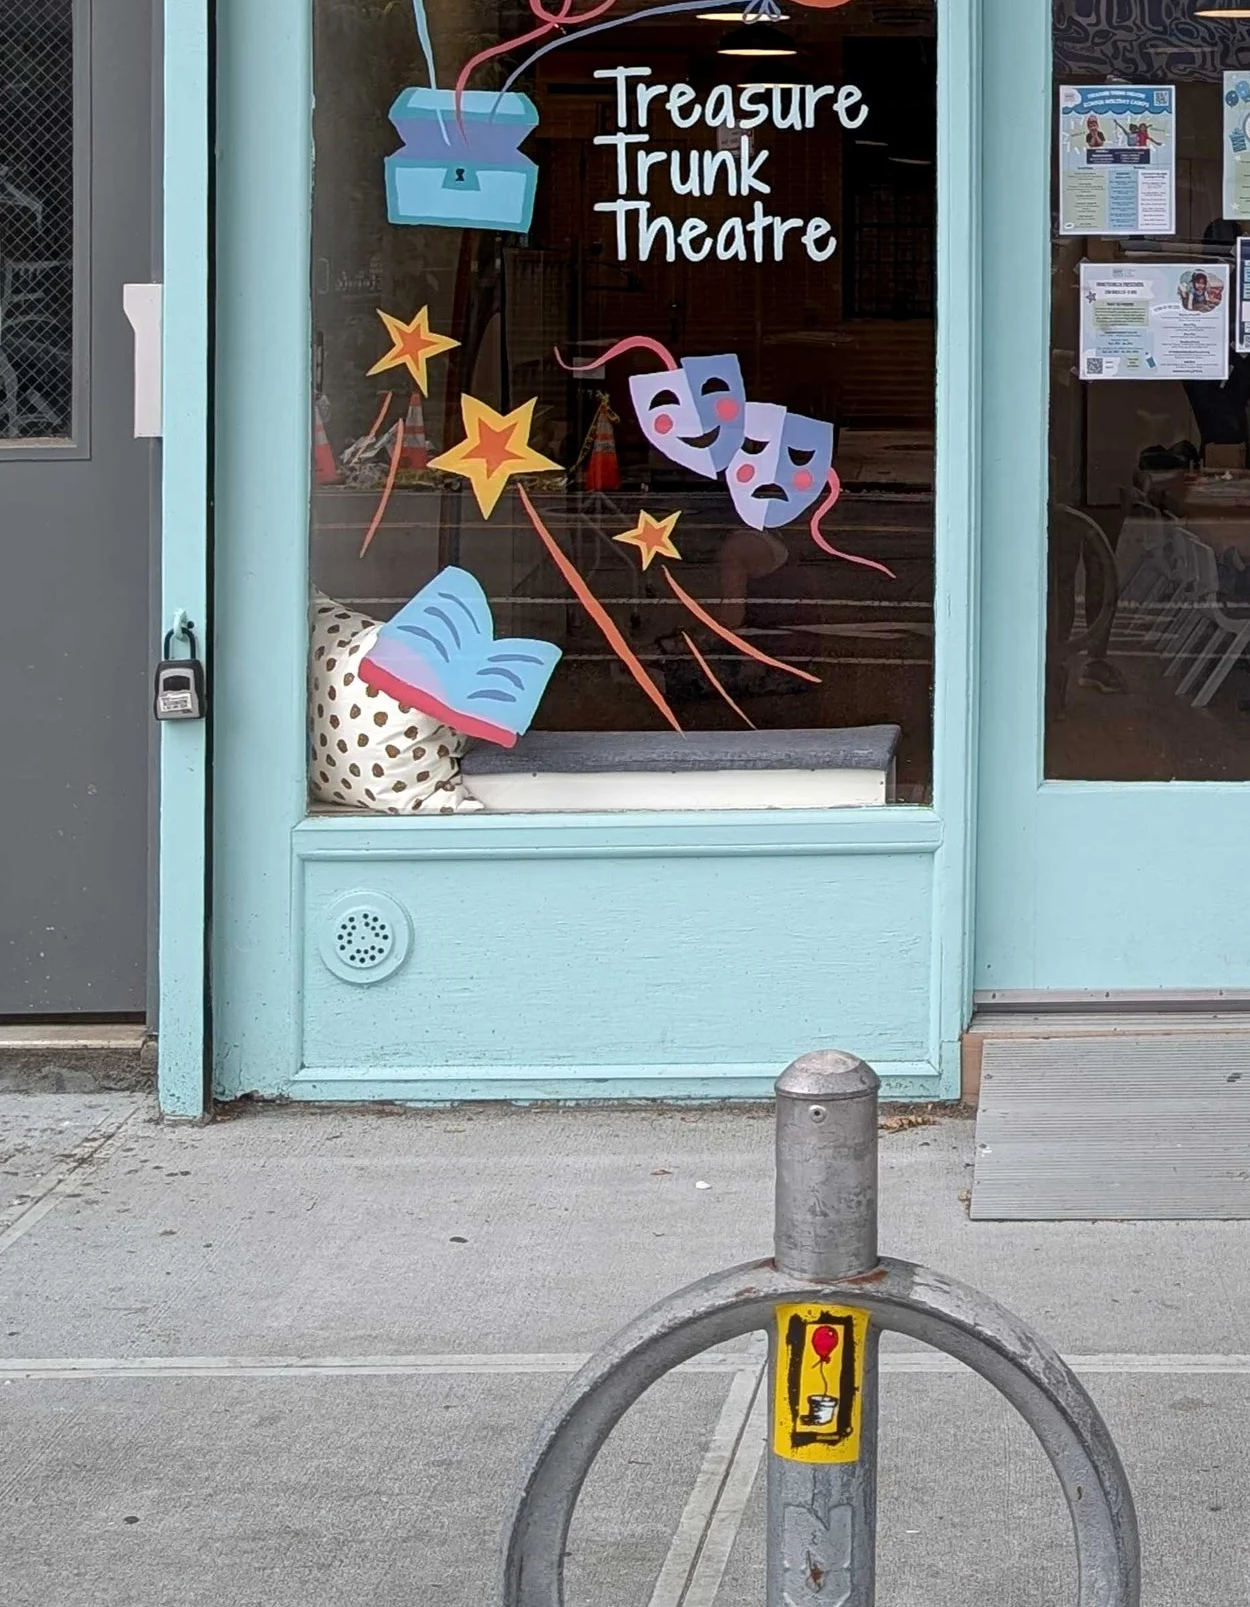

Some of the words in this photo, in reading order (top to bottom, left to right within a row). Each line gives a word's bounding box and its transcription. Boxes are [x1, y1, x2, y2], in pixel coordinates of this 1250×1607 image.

[594, 67, 868, 130] Treasure
[594, 133, 770, 196] Trunk
[594, 199, 836, 262] Theatre
